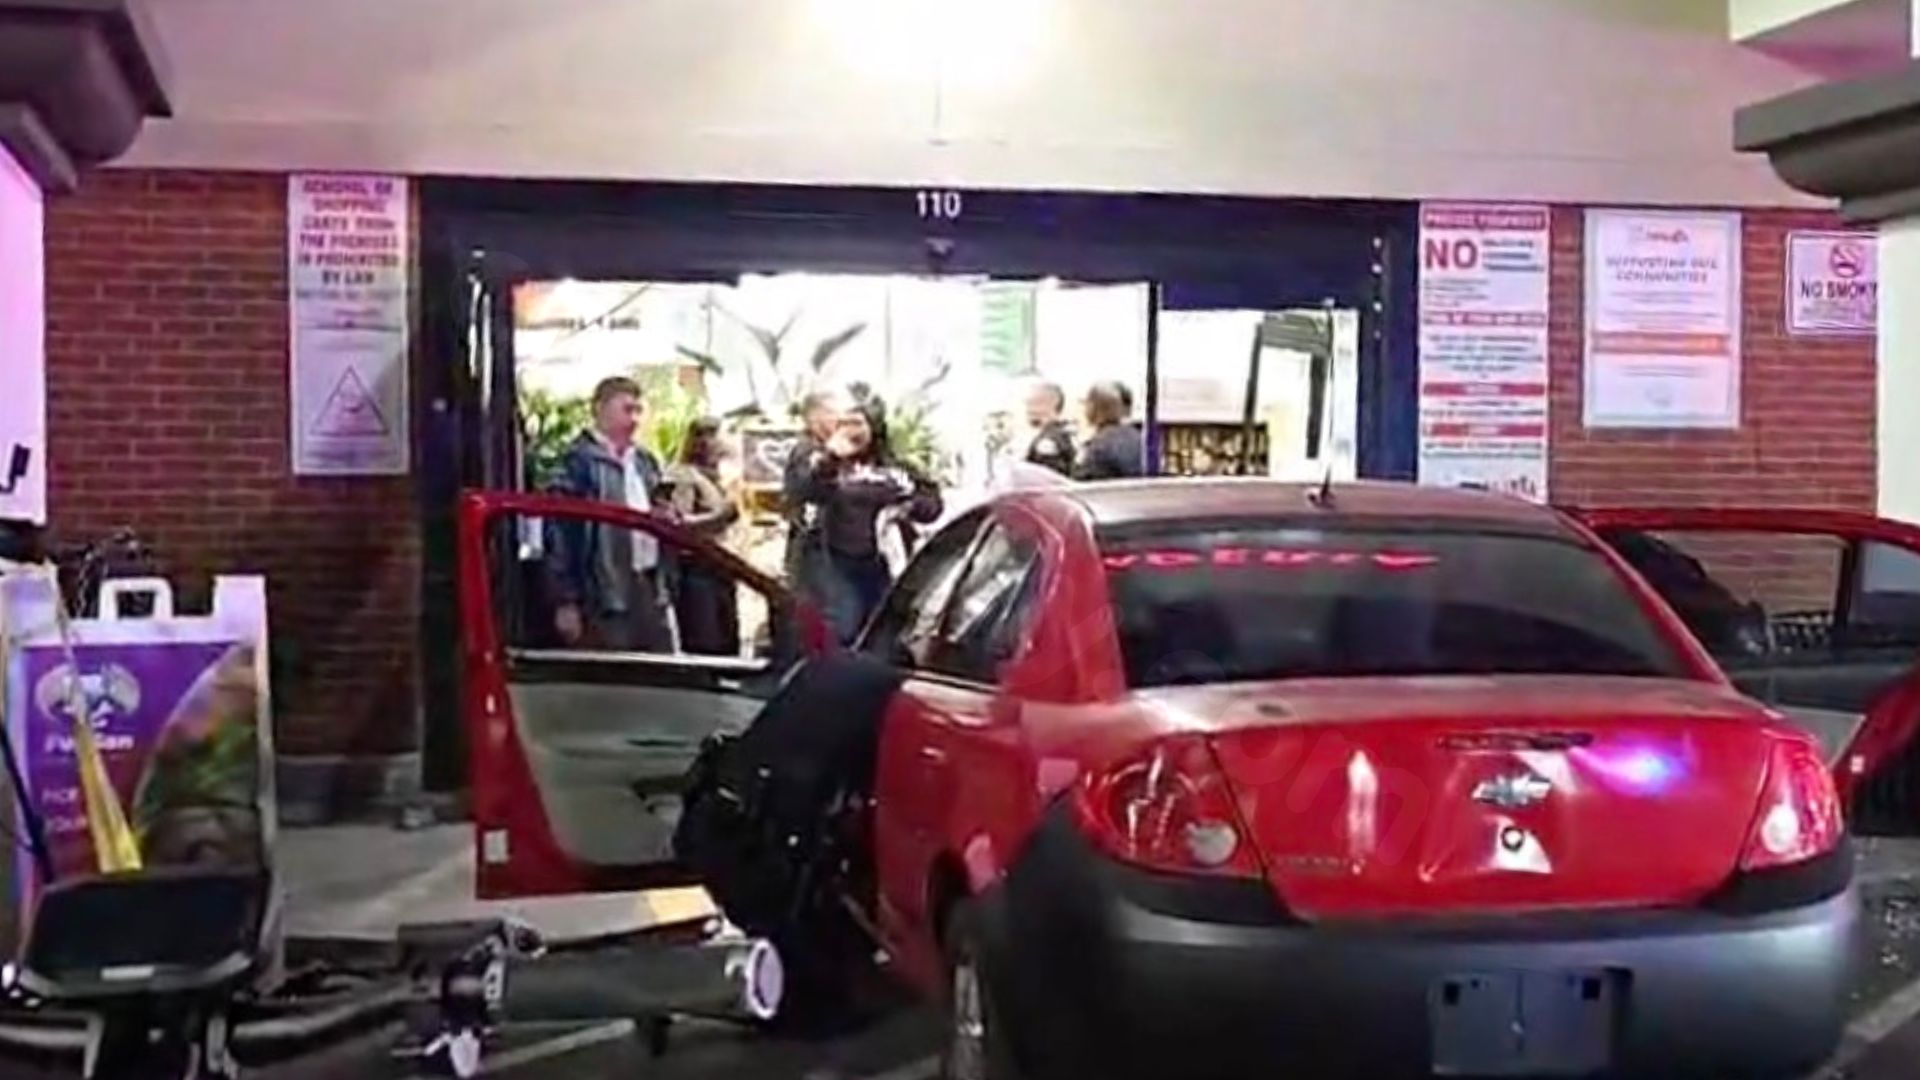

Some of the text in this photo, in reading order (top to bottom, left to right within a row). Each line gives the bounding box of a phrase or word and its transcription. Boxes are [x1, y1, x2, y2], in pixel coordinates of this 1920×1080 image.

[917, 190, 961, 219] 110
[1425, 238, 1478, 269] NO
[1801, 281, 1823, 298] NO
